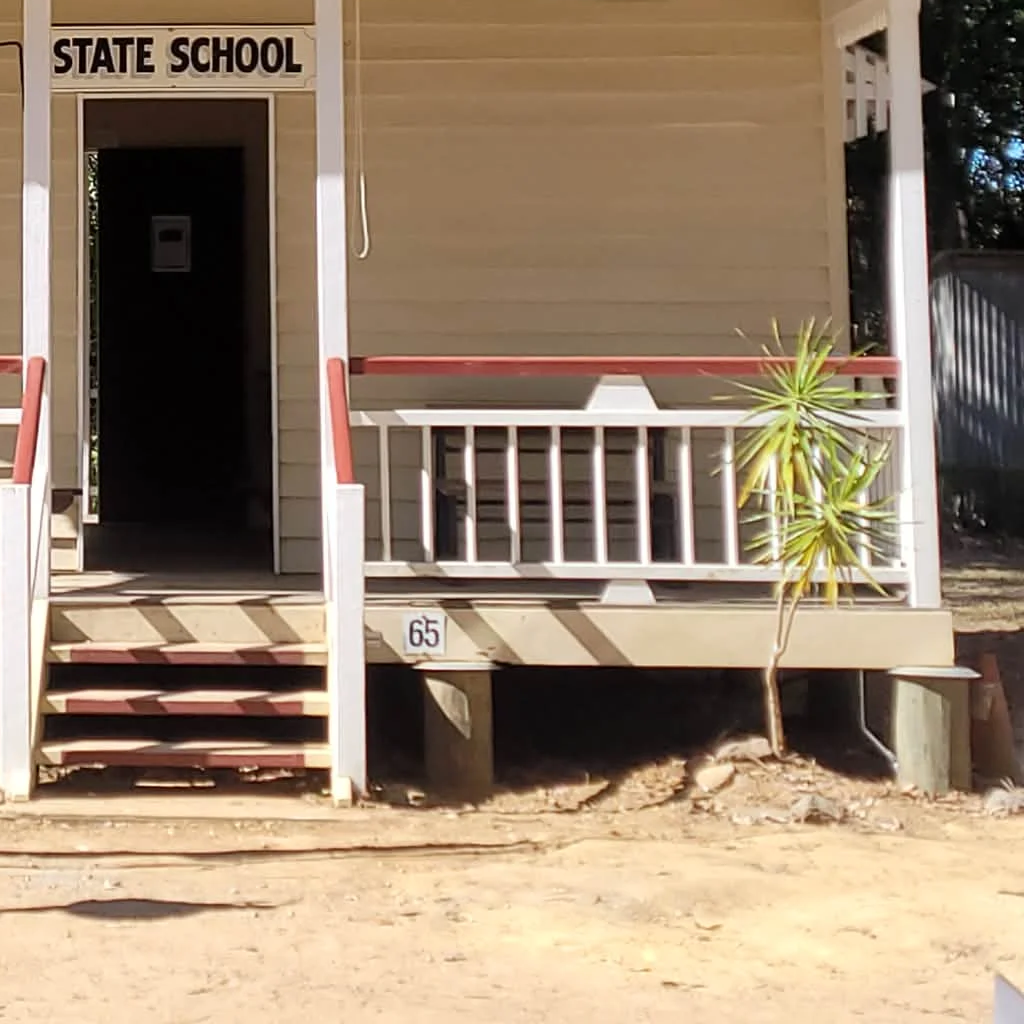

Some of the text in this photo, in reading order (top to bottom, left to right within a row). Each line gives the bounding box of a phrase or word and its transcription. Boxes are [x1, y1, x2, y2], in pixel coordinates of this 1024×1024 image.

[53, 36, 303, 74] STATE SCHOOL
[409, 618, 440, 648] 65
